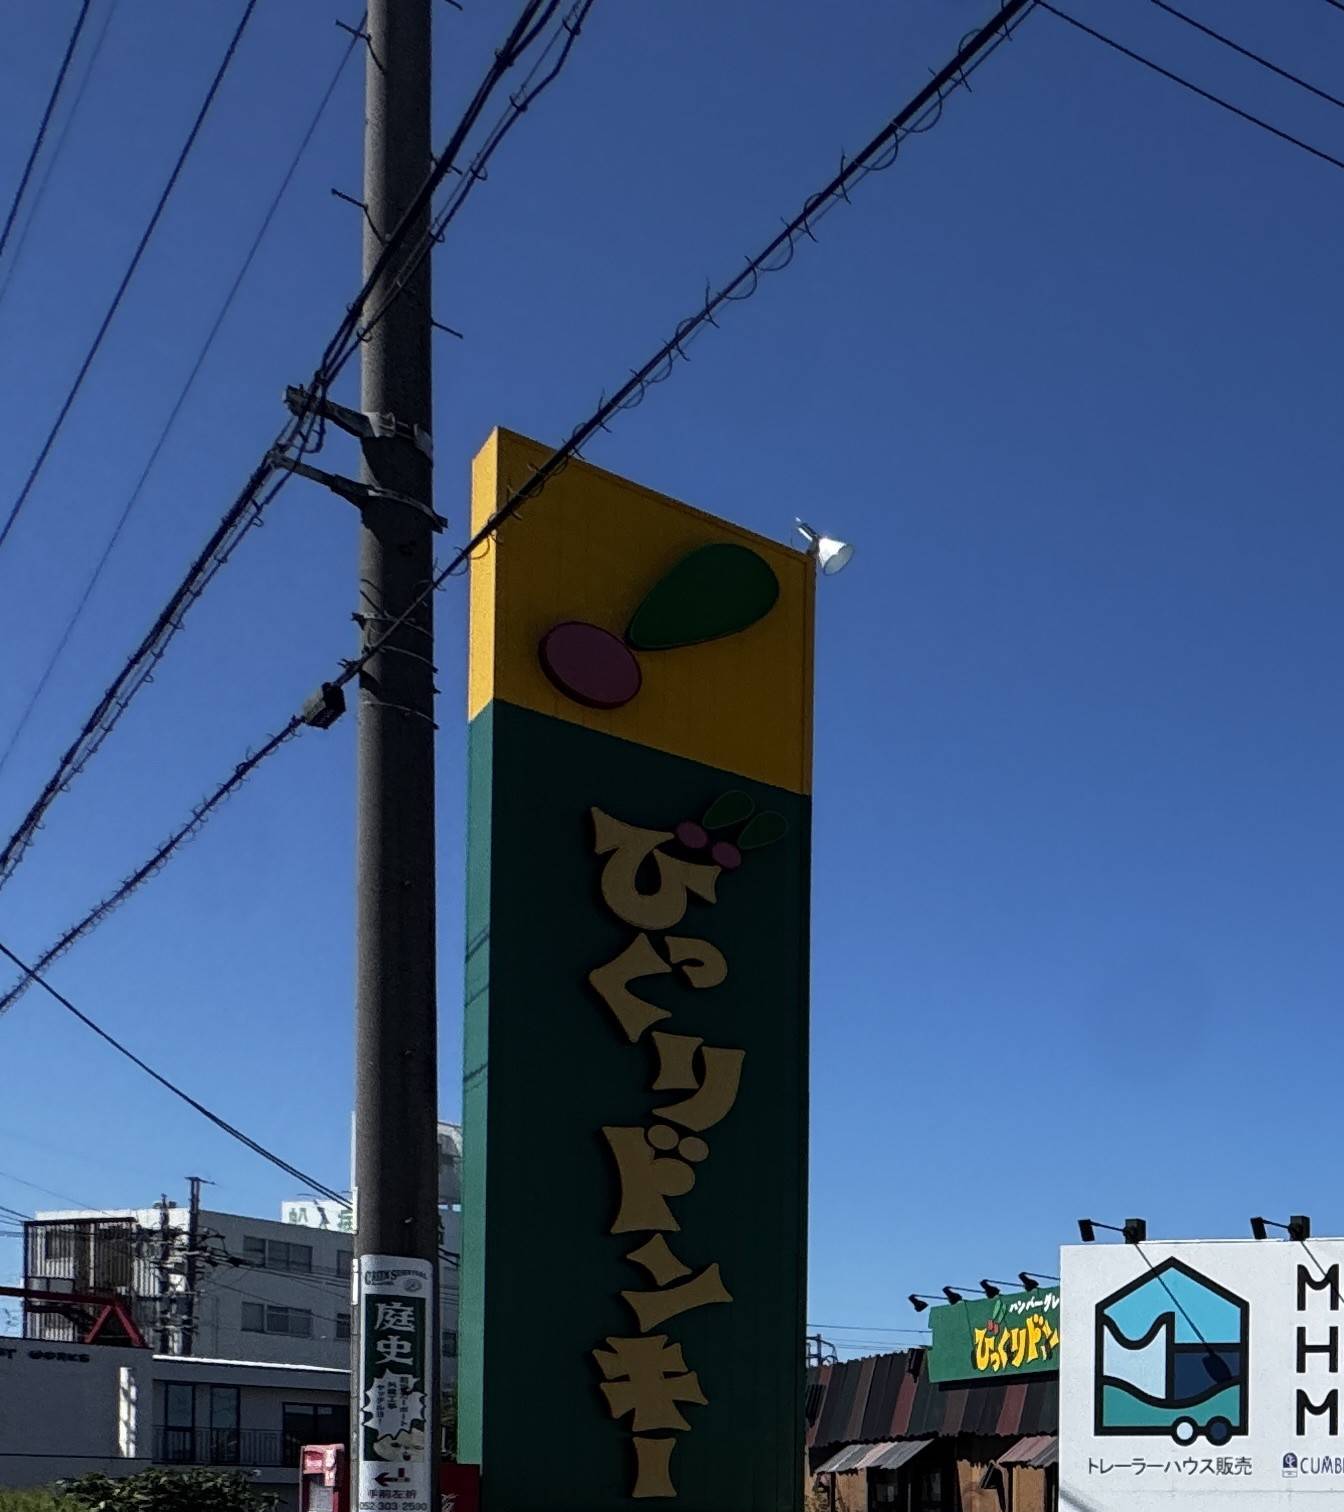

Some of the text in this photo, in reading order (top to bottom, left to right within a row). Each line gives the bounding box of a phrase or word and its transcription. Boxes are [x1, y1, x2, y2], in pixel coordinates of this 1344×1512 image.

[589, 806, 746, 1498] びっくりドンキー
[374, 1301, 415, 1365] 庭史
[1088, 1456, 1253, 1476] トレーラーハウス販売
